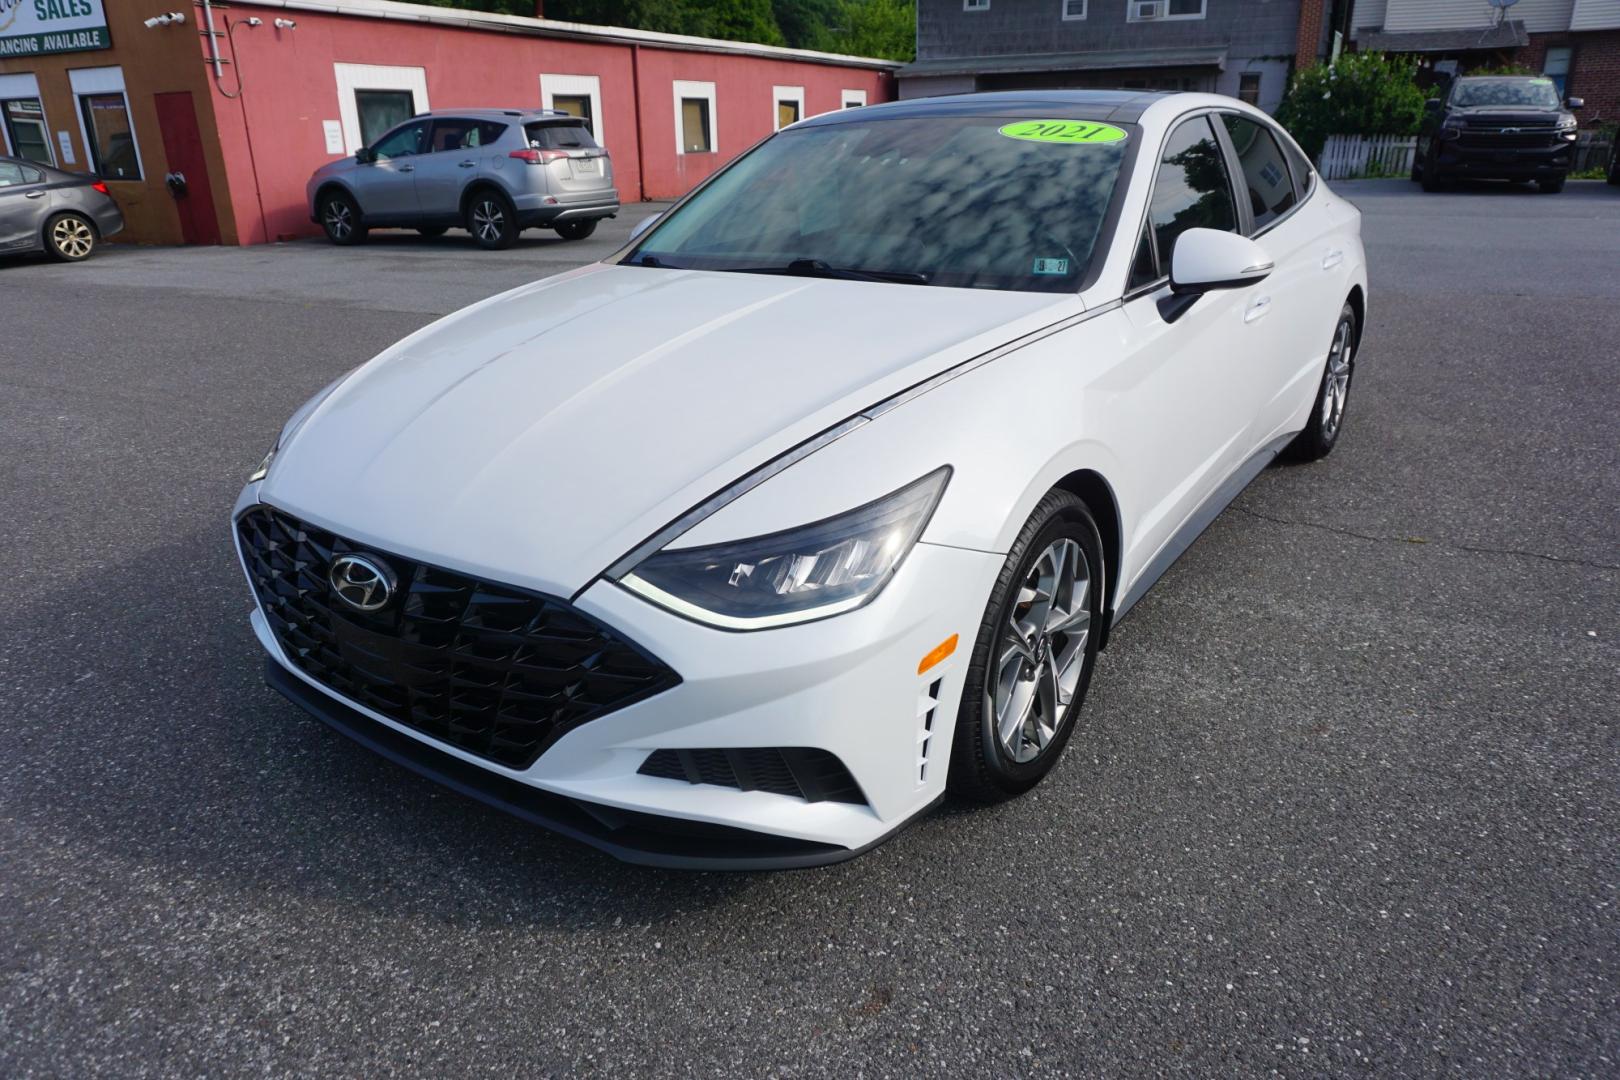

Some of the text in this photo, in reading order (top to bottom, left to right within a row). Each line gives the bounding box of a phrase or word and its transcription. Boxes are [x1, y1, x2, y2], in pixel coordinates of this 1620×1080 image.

[34, 0, 92, 21] SALES
[0, 31, 100, 54] ANCING AVAILABLE
[1016, 123, 1105, 139] 2021
